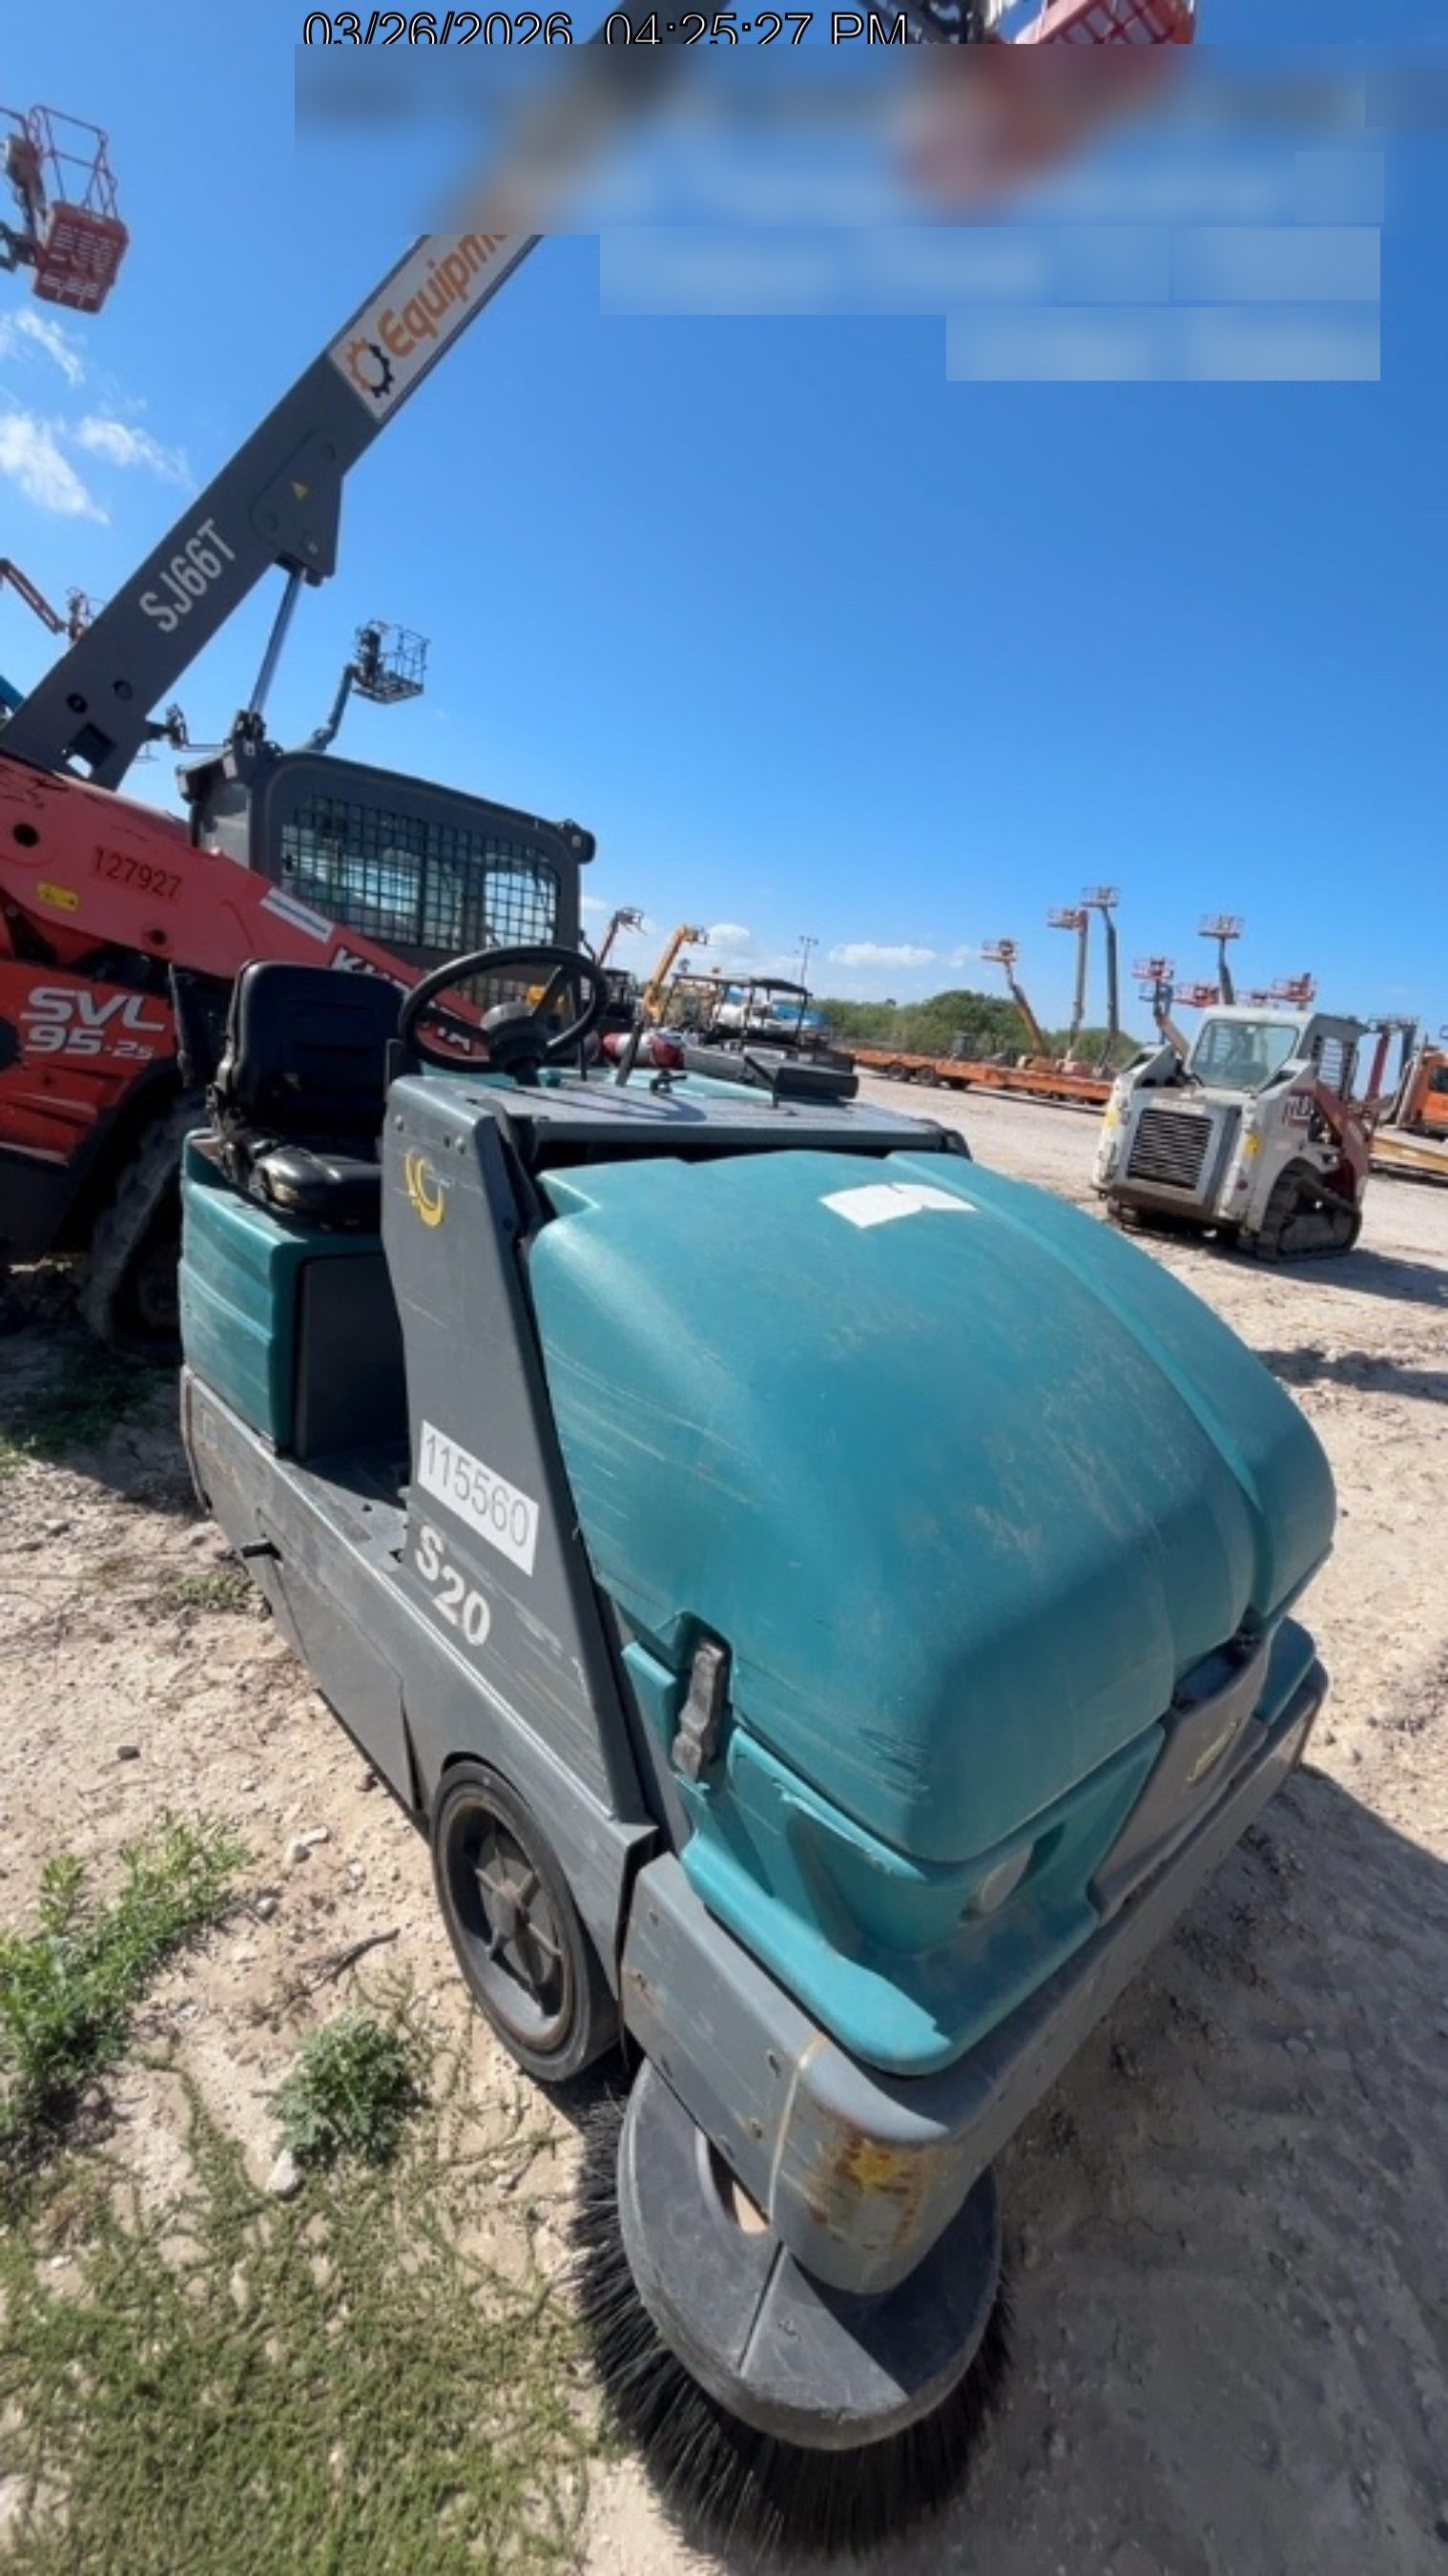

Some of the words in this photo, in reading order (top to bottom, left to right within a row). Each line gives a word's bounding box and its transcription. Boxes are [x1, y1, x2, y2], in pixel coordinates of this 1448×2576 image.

[378, 235, 507, 359] Equipm
[139, 518, 236, 634] SJ66T
[95, 844, 182, 901] 127927
[19, 987, 166, 1031] SVL
[425, 1433, 529, 1548] 115560
[415, 1525, 490, 1647] S20
